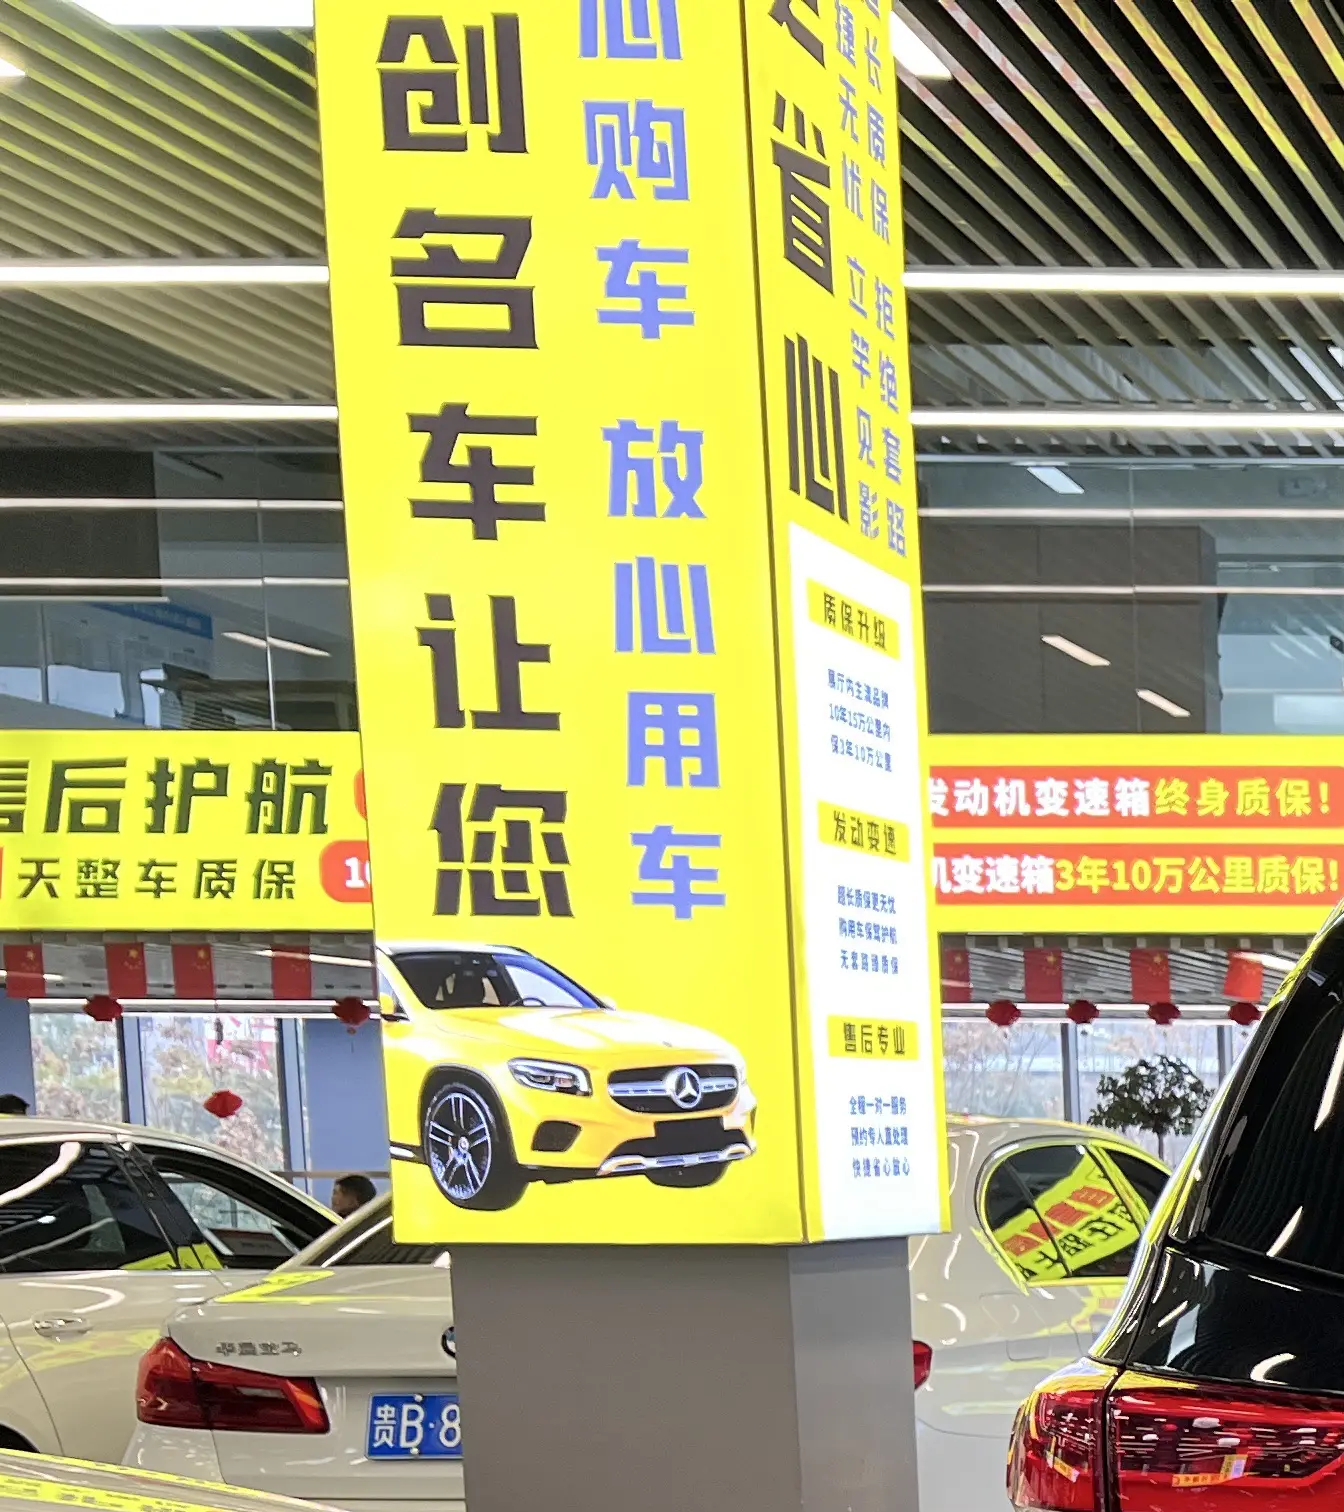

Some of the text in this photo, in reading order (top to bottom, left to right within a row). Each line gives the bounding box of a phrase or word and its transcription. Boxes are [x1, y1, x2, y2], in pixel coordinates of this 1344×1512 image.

[862, 0, 907, 558] 长质保 拒绝套路
[377, 13, 575, 917] 创名车让您
[824, 592, 887, 650] 质保升级
[833, 810, 897, 856] 发动变速
[17, 857, 296, 900] 天整车质保
[844, 1022, 906, 1055] 售后专业
